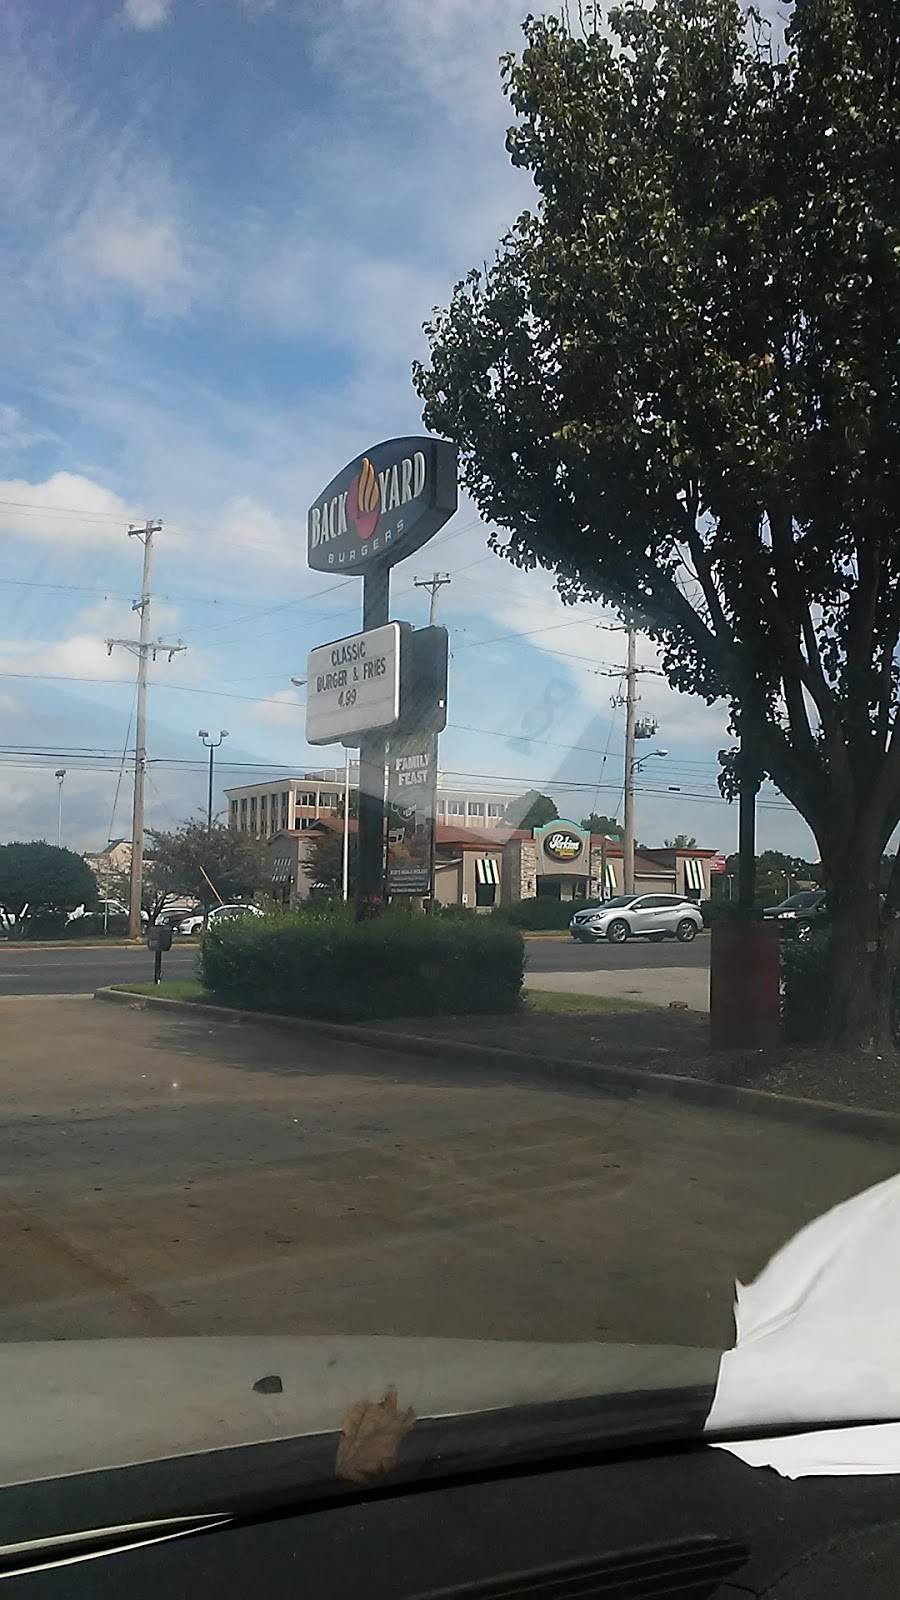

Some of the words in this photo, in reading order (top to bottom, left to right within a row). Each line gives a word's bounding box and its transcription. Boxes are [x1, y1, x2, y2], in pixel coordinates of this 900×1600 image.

[311, 491, 348, 549] BACK
[378, 451, 426, 514] YARD
[328, 519, 404, 564] BURGERS
[331, 641, 366, 667] CLASSIC
[316, 669, 348, 693] BURGER
[352, 667, 359, 681] &
[363, 657, 386, 680] FRIES
[395, 753, 430, 771] FAMILY
[398, 769, 428, 786] FEAST
[549, 834, 580, 850] Perkins
